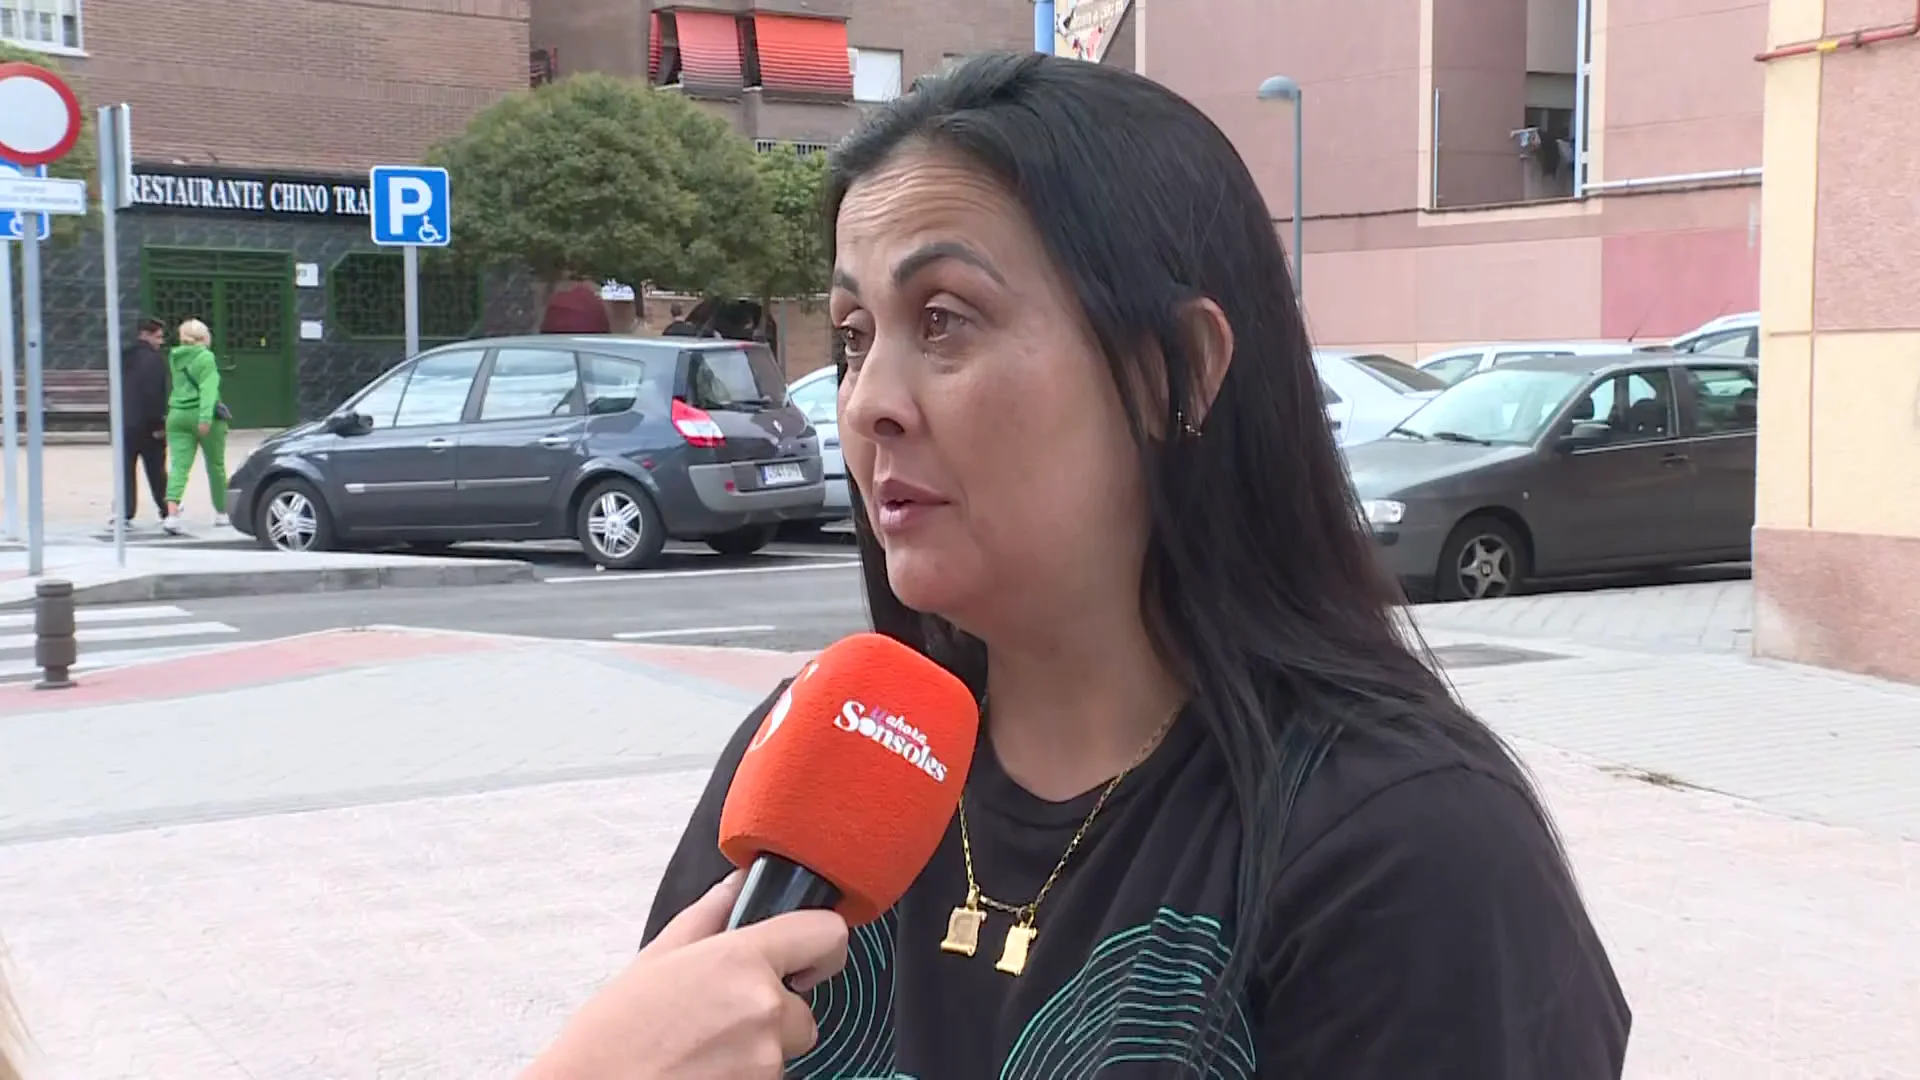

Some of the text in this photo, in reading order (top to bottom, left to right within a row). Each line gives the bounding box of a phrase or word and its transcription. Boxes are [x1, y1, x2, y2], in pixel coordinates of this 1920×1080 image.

[128, 174, 371, 215] RESTAURANTE CHINO TRA
[388, 176, 433, 235] P
[833, 699, 948, 783] Sonsoles
